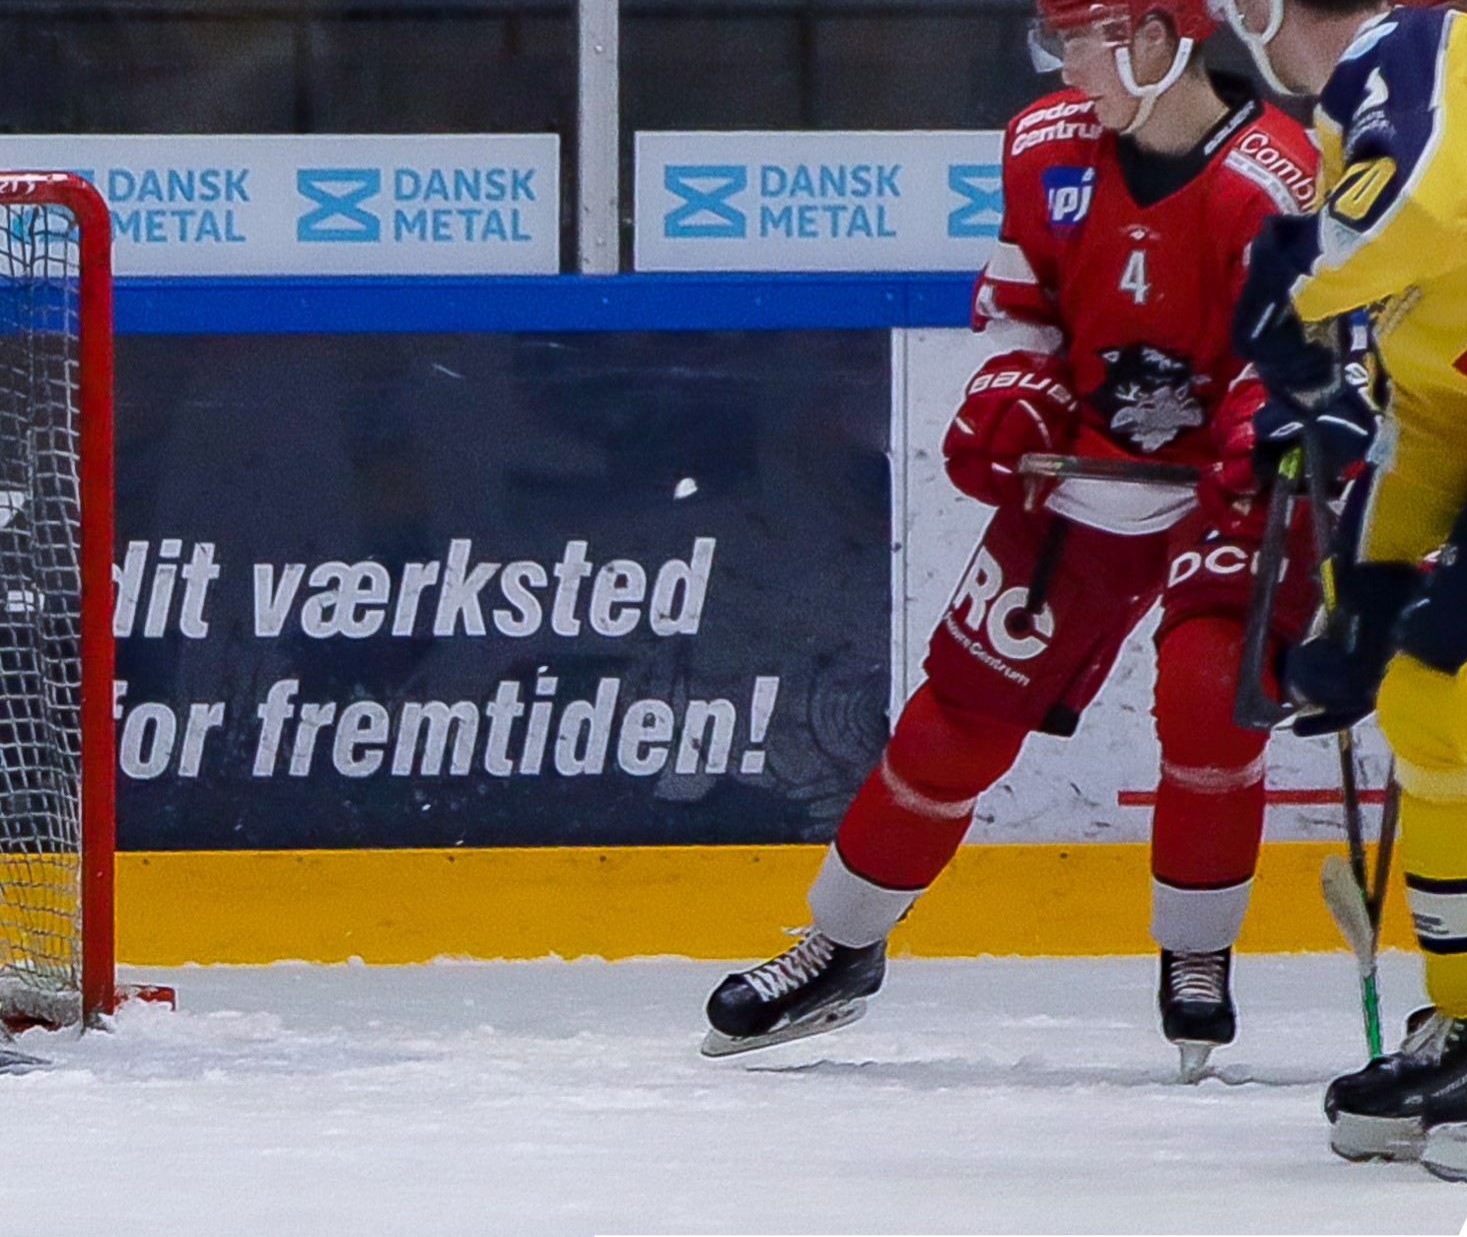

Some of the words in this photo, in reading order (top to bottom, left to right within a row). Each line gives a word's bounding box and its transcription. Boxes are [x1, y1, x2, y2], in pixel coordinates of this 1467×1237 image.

[108, 168, 250, 202] DANSK
[393, 167, 535, 201] DANSK
[759, 164, 902, 197] DANSK
[110, 208, 246, 243] METAL
[393, 207, 532, 242] METAL
[759, 205, 897, 238] METAL
[1118, 250, 1151, 304] 4
[253, 537, 716, 638] værksted
[256, 676, 780, 778] fremtiden!
